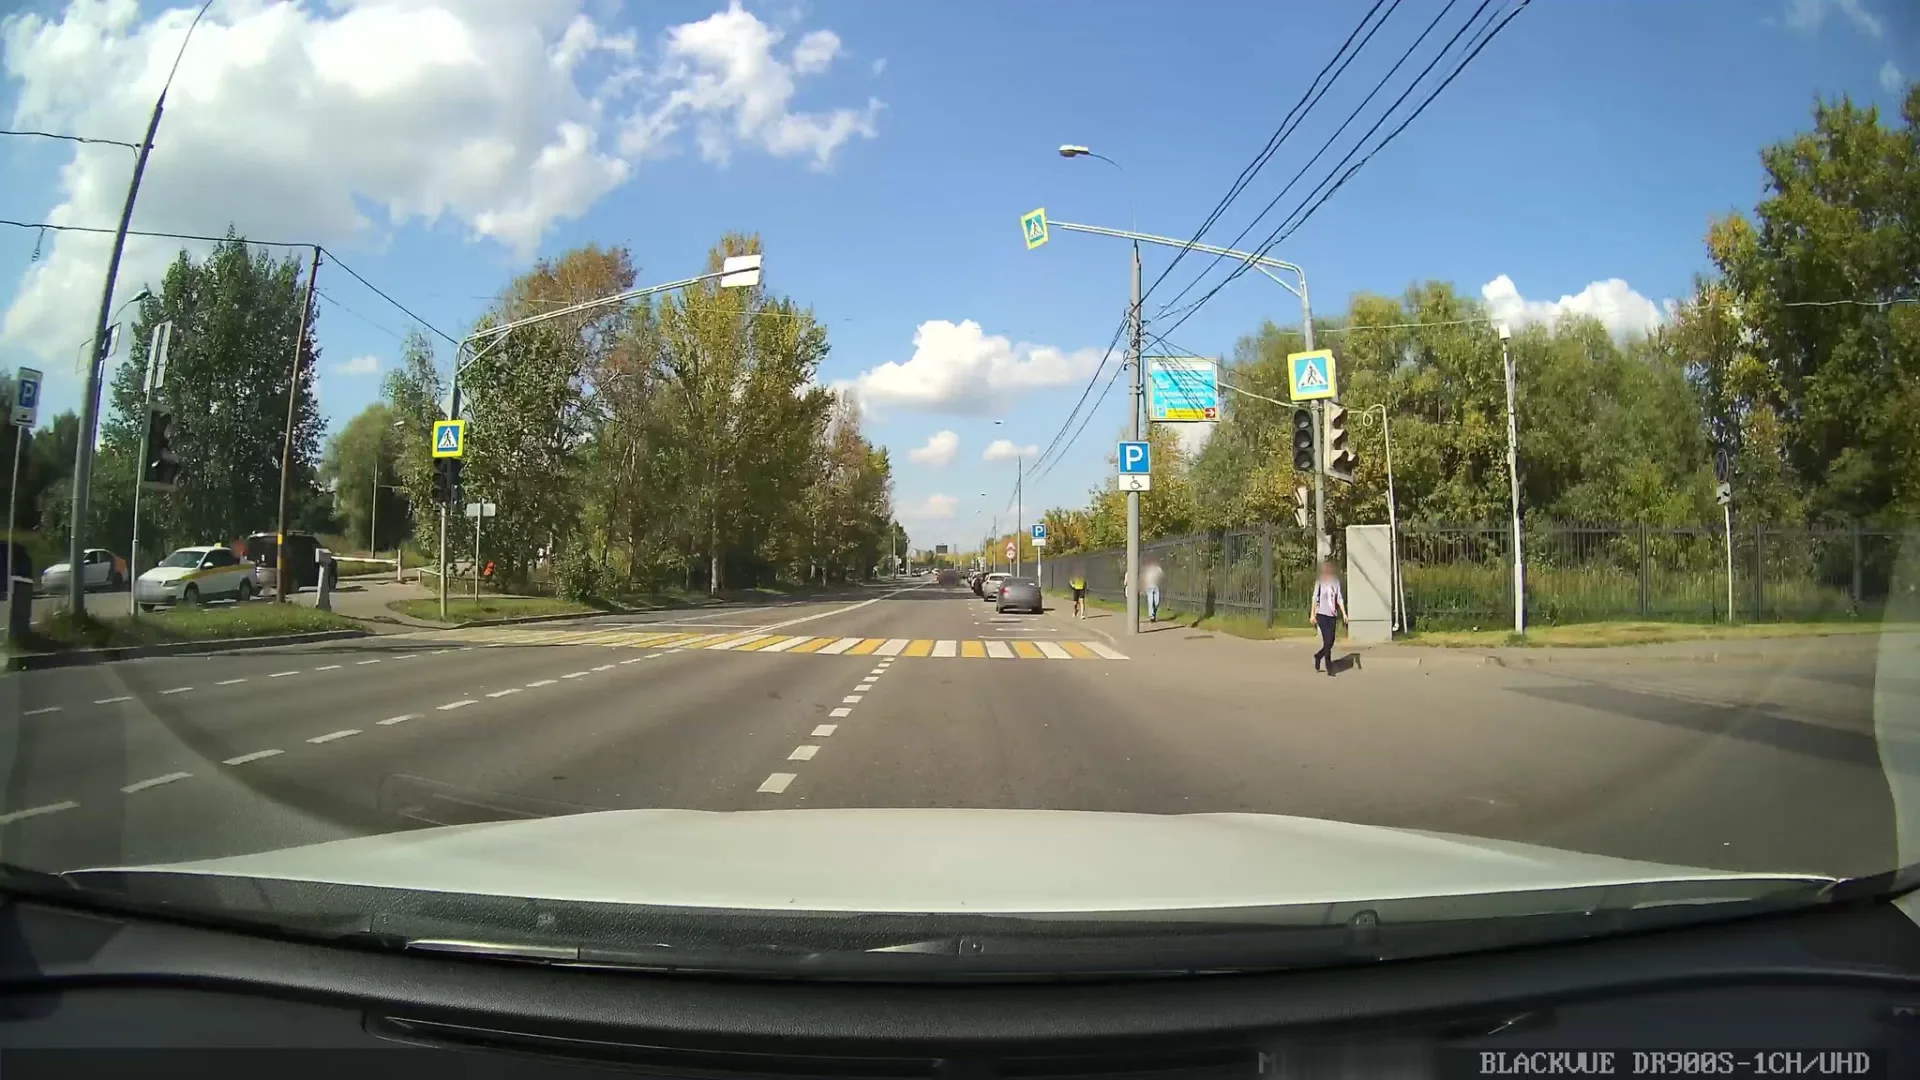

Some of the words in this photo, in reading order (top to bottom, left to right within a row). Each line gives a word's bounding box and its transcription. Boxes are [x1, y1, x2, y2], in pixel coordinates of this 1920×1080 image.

[22, 382, 34, 405] P
[1125, 445, 1144, 471] P
[1035, 526, 1044, 537] P
